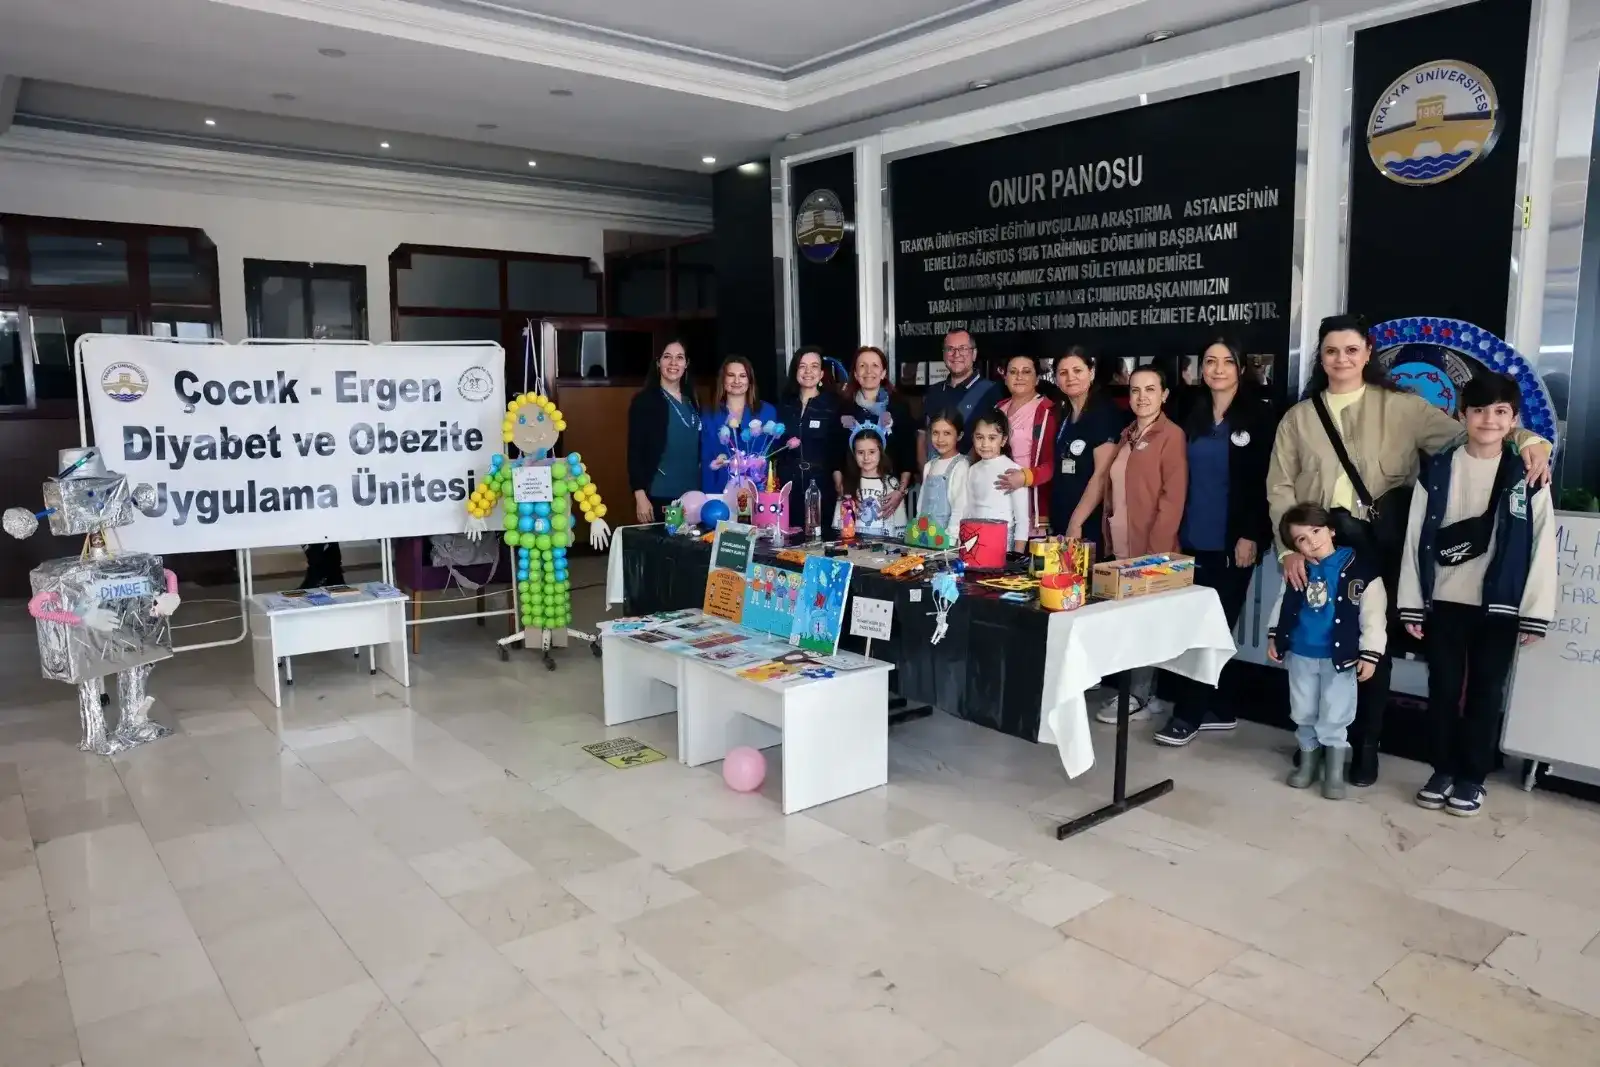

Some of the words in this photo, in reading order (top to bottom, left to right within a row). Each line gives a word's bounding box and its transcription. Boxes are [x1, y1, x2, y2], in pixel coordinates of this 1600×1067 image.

[1373, 83, 1410, 132] TRAKYA
[988, 172, 1046, 208] ONUR
[1051, 154, 1143, 199] PANOSU
[899, 236, 934, 254] TRAKYA
[935, 224, 1000, 250] ÜNİVERSİTESİ
[1001, 220, 1036, 241] EĞİTİM
[1037, 213, 1099, 236] UYGULAMA
[1100, 203, 1173, 229] ARAŞTIRMA
[923, 252, 957, 272] TEMELİ
[957, 254, 968, 269] 23
[968, 248, 1016, 268] AĞUSTOS
[1016, 245, 1039, 262] 1976
[1040, 237, 1100, 260] TARİHİNDE
[1100, 228, 1157, 253] DÖNEMİN
[1159, 221, 1239, 248] BAŞBAKANI
[1046, 264, 1079, 282] SAYIN
[1080, 258, 1145, 279] SÜLEYMAN
[1147, 251, 1205, 273] DEMİREL
[1026, 291, 1042, 308] VE
[1087, 277, 1230, 303] CUMHURBAŞKANIMIZIN
[987, 315, 1003, 333] İLE
[1004, 316, 1017, 332] 25
[1077, 307, 1138, 328] TARİHİNDE
[1140, 304, 1196, 325] HİZMETE
[1197, 301, 1280, 326] AÇILMIŞTIR.
[173, 370, 300, 414] Çocuk
[335, 370, 443, 412] Ergen
[122, 424, 283, 470] Diyabet
[292, 431, 336, 457] ve
[348, 420, 484, 456] Obezite
[141, 480, 339, 526] Uygulama
[351, 468, 476, 507] Ünitesi
[1440, 541, 1472, 557] Reebok
[1555, 524, 1579, 560] 14
[1347, 578, 1365, 601] C
